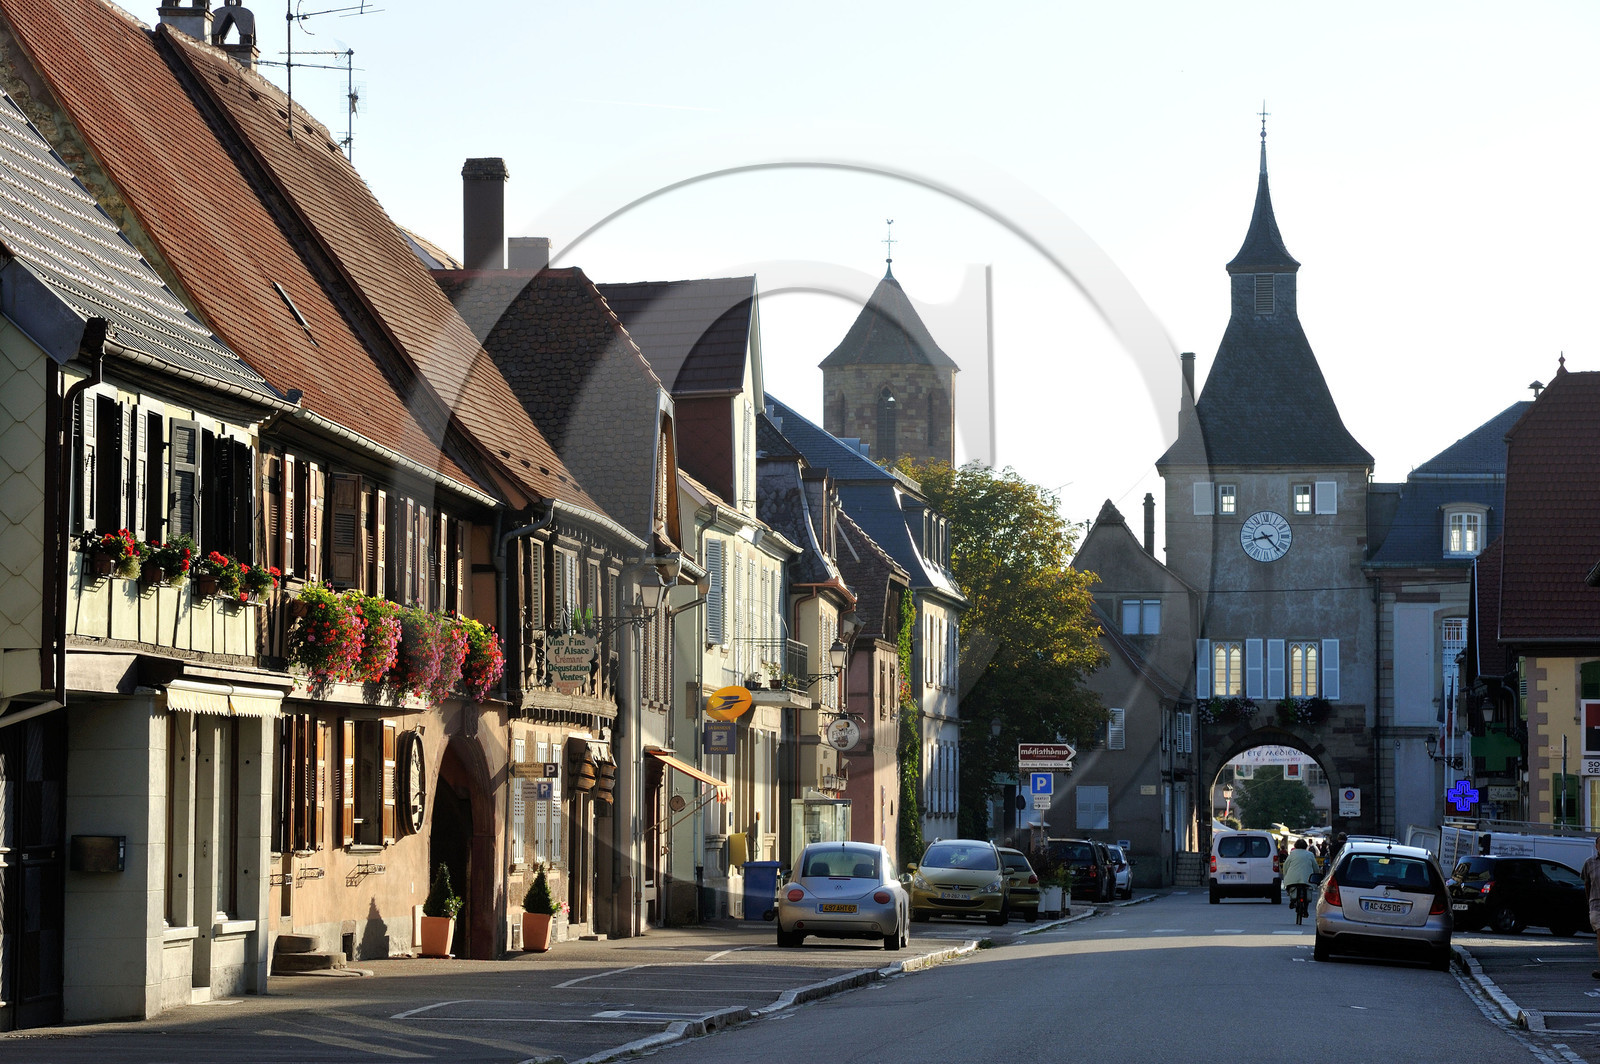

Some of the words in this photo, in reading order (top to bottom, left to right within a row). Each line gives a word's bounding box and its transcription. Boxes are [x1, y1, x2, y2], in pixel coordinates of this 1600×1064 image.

[547, 637, 565, 646] Vins
[568, 637, 586, 646] Fins
[554, 655, 584, 664] Crémant
[548, 663, 590, 673] Dégustation
[558, 672, 584, 681] Ventes
[546, 764, 555, 776] P
[1036, 777, 1047, 791] P
[540, 784, 549, 795] P
